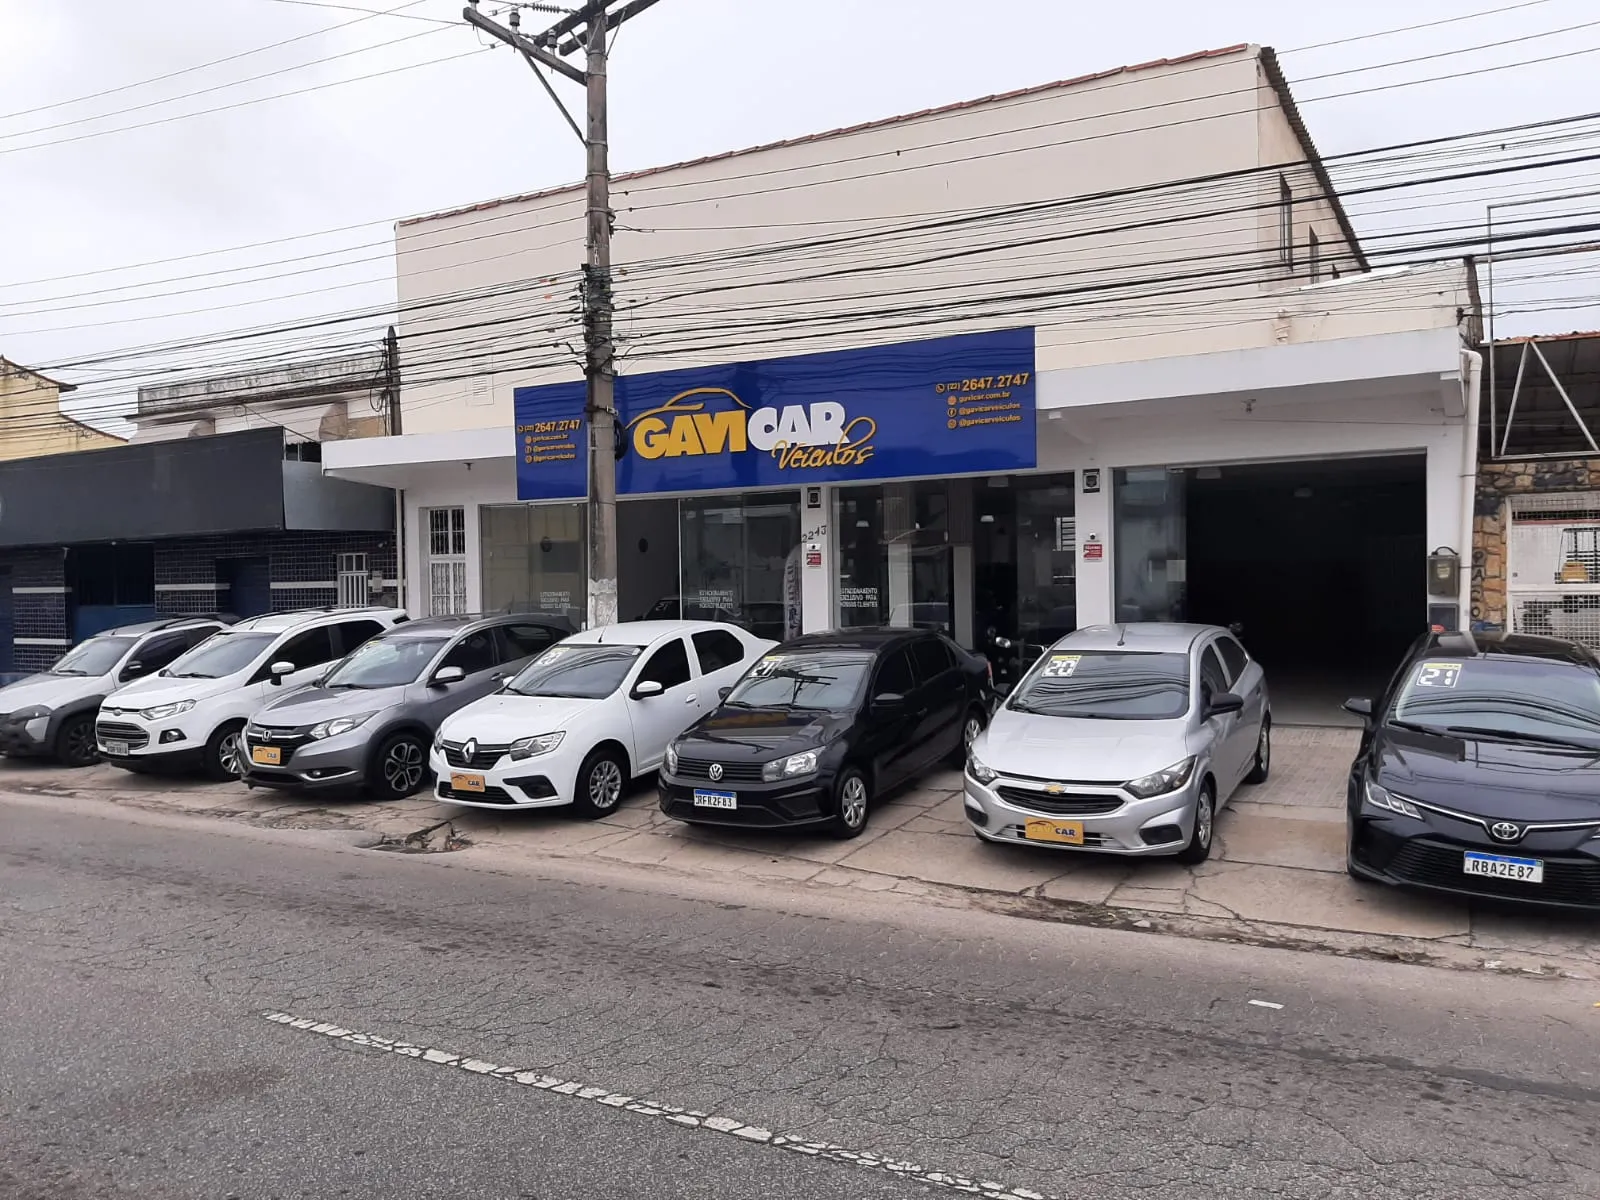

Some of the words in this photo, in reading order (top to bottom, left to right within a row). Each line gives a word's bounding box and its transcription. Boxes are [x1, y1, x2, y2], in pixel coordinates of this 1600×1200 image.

[962, 372, 1029, 392] 2647.2747
[534, 419, 580, 433] 2647.2747
[1044, 660, 1075, 675] 20
[1420, 668, 1453, 685] 21
[1471, 859, 1534, 879] RBA2E87
